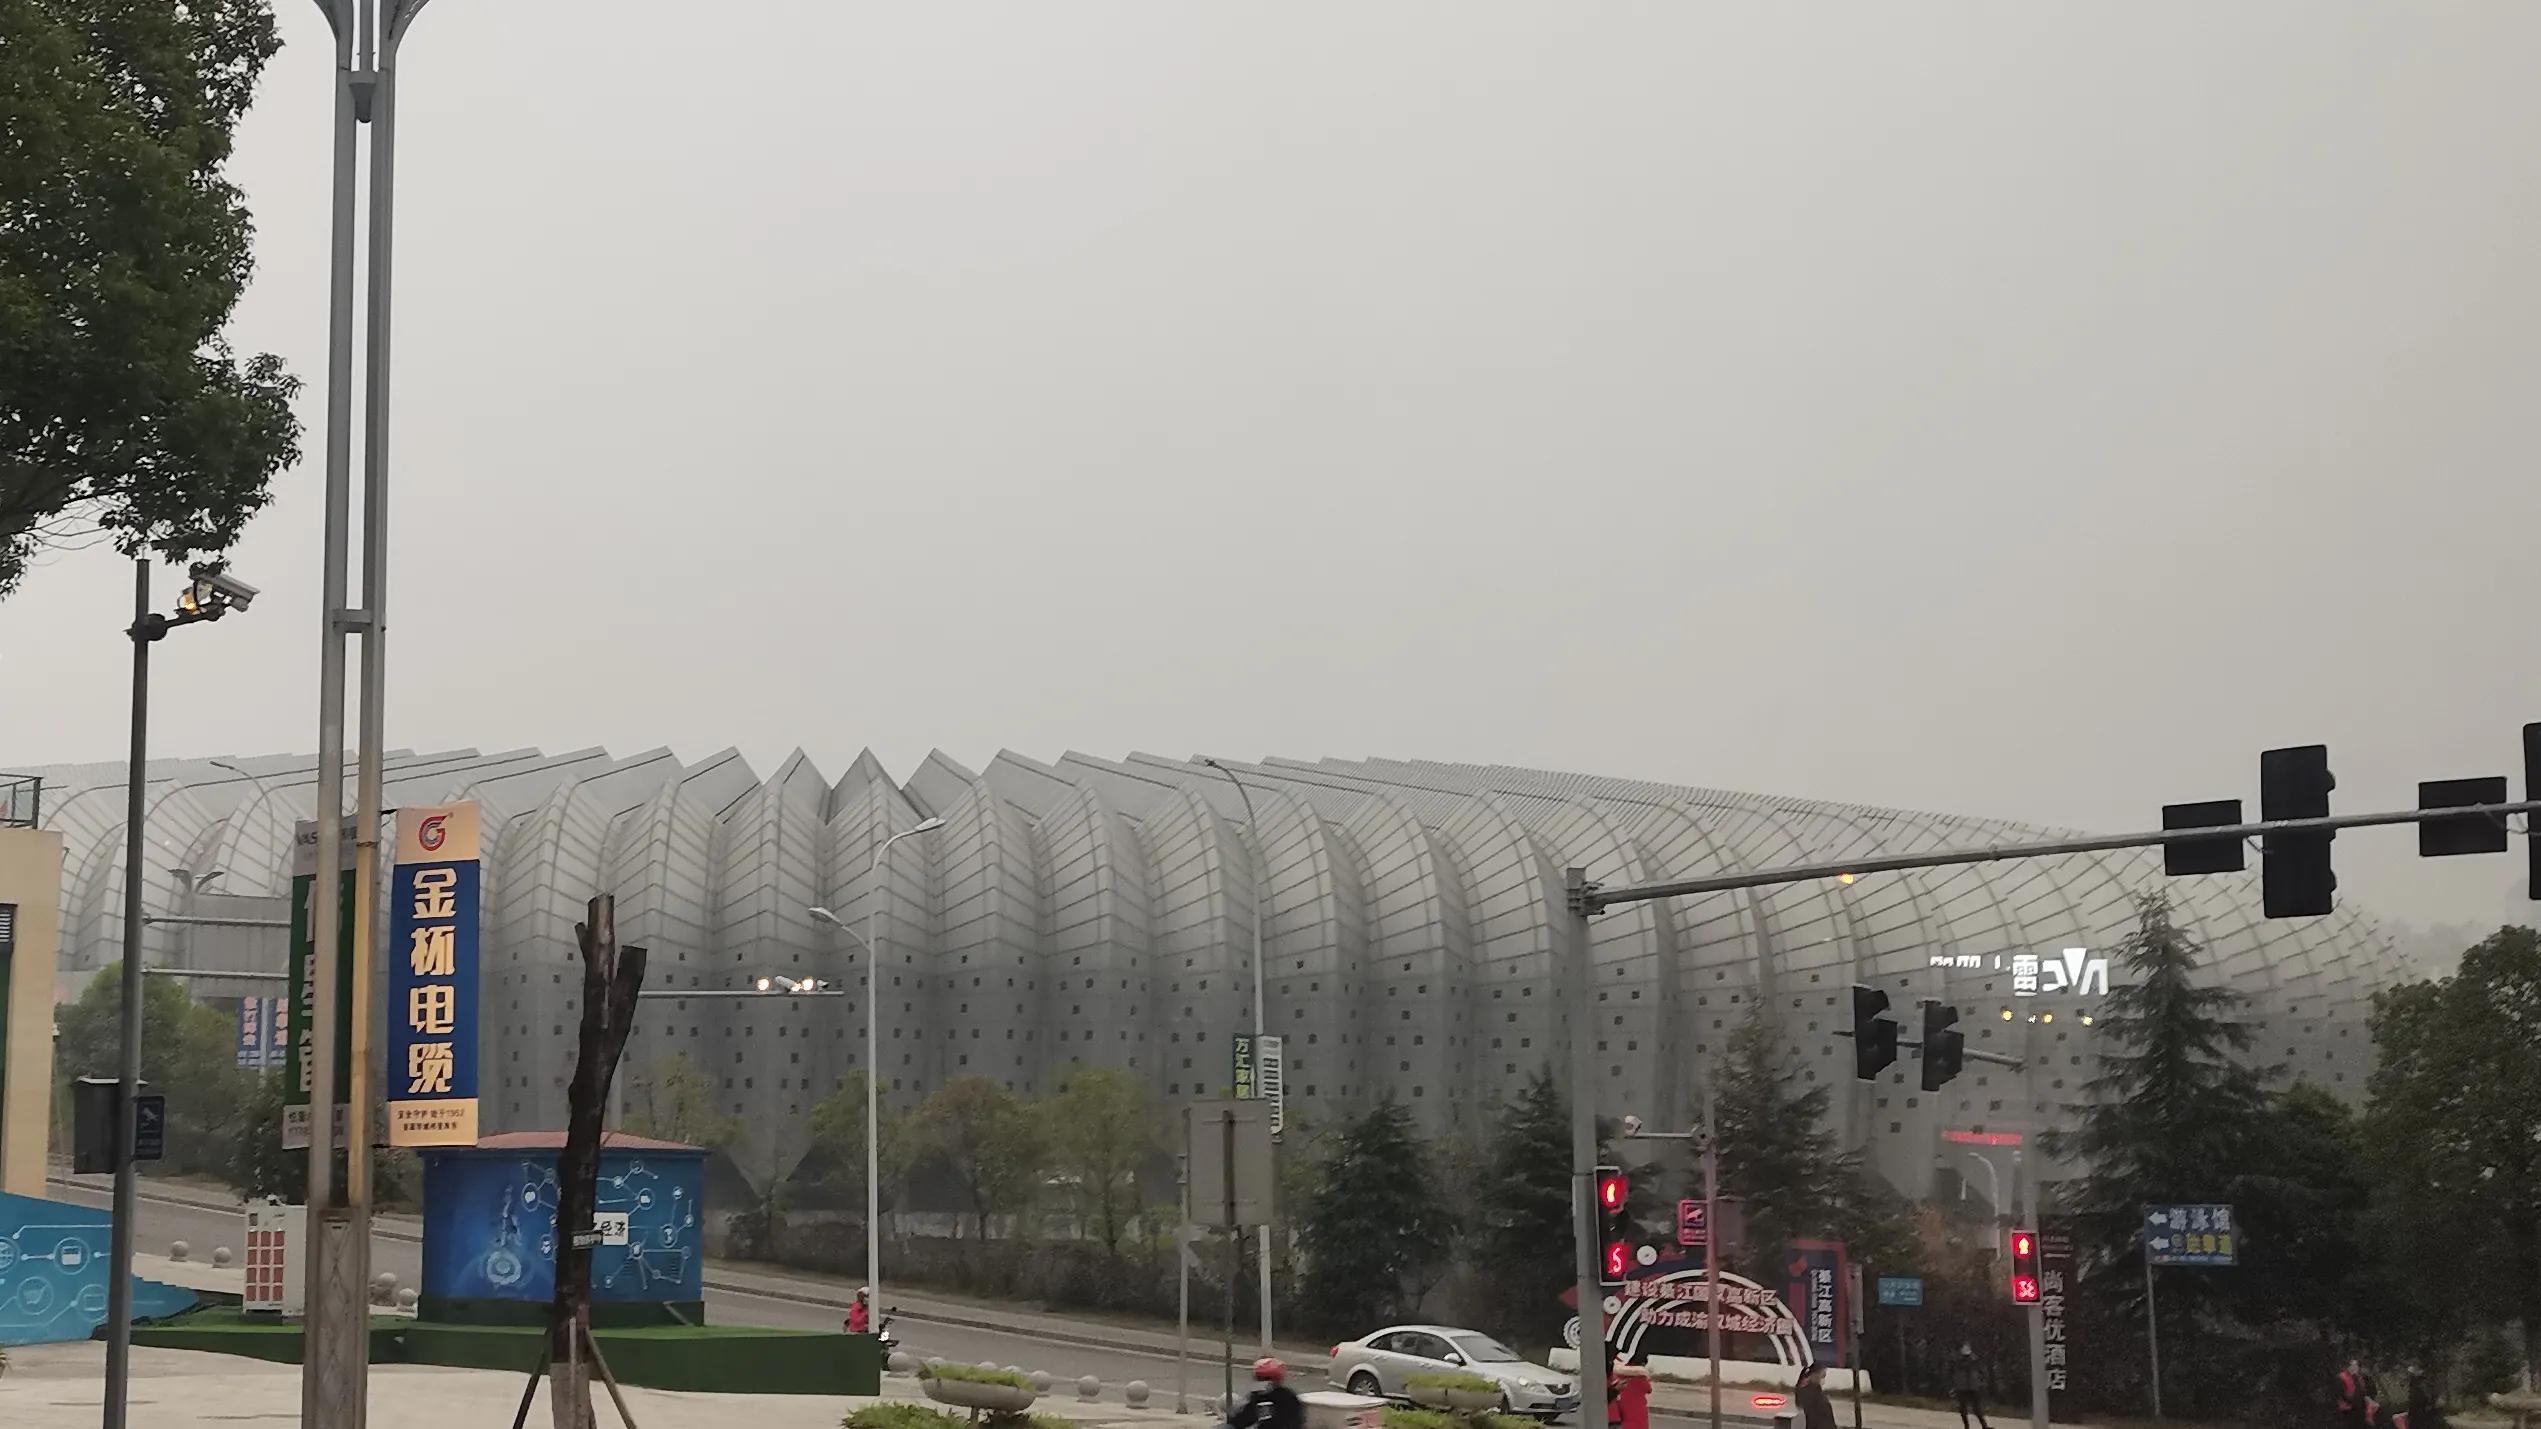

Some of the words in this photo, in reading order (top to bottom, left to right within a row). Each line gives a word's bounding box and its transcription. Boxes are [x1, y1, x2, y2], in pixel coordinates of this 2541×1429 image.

[409, 868, 458, 1094] 金杯电缆
[2043, 1270, 2068, 1391] 尚客优酒店
